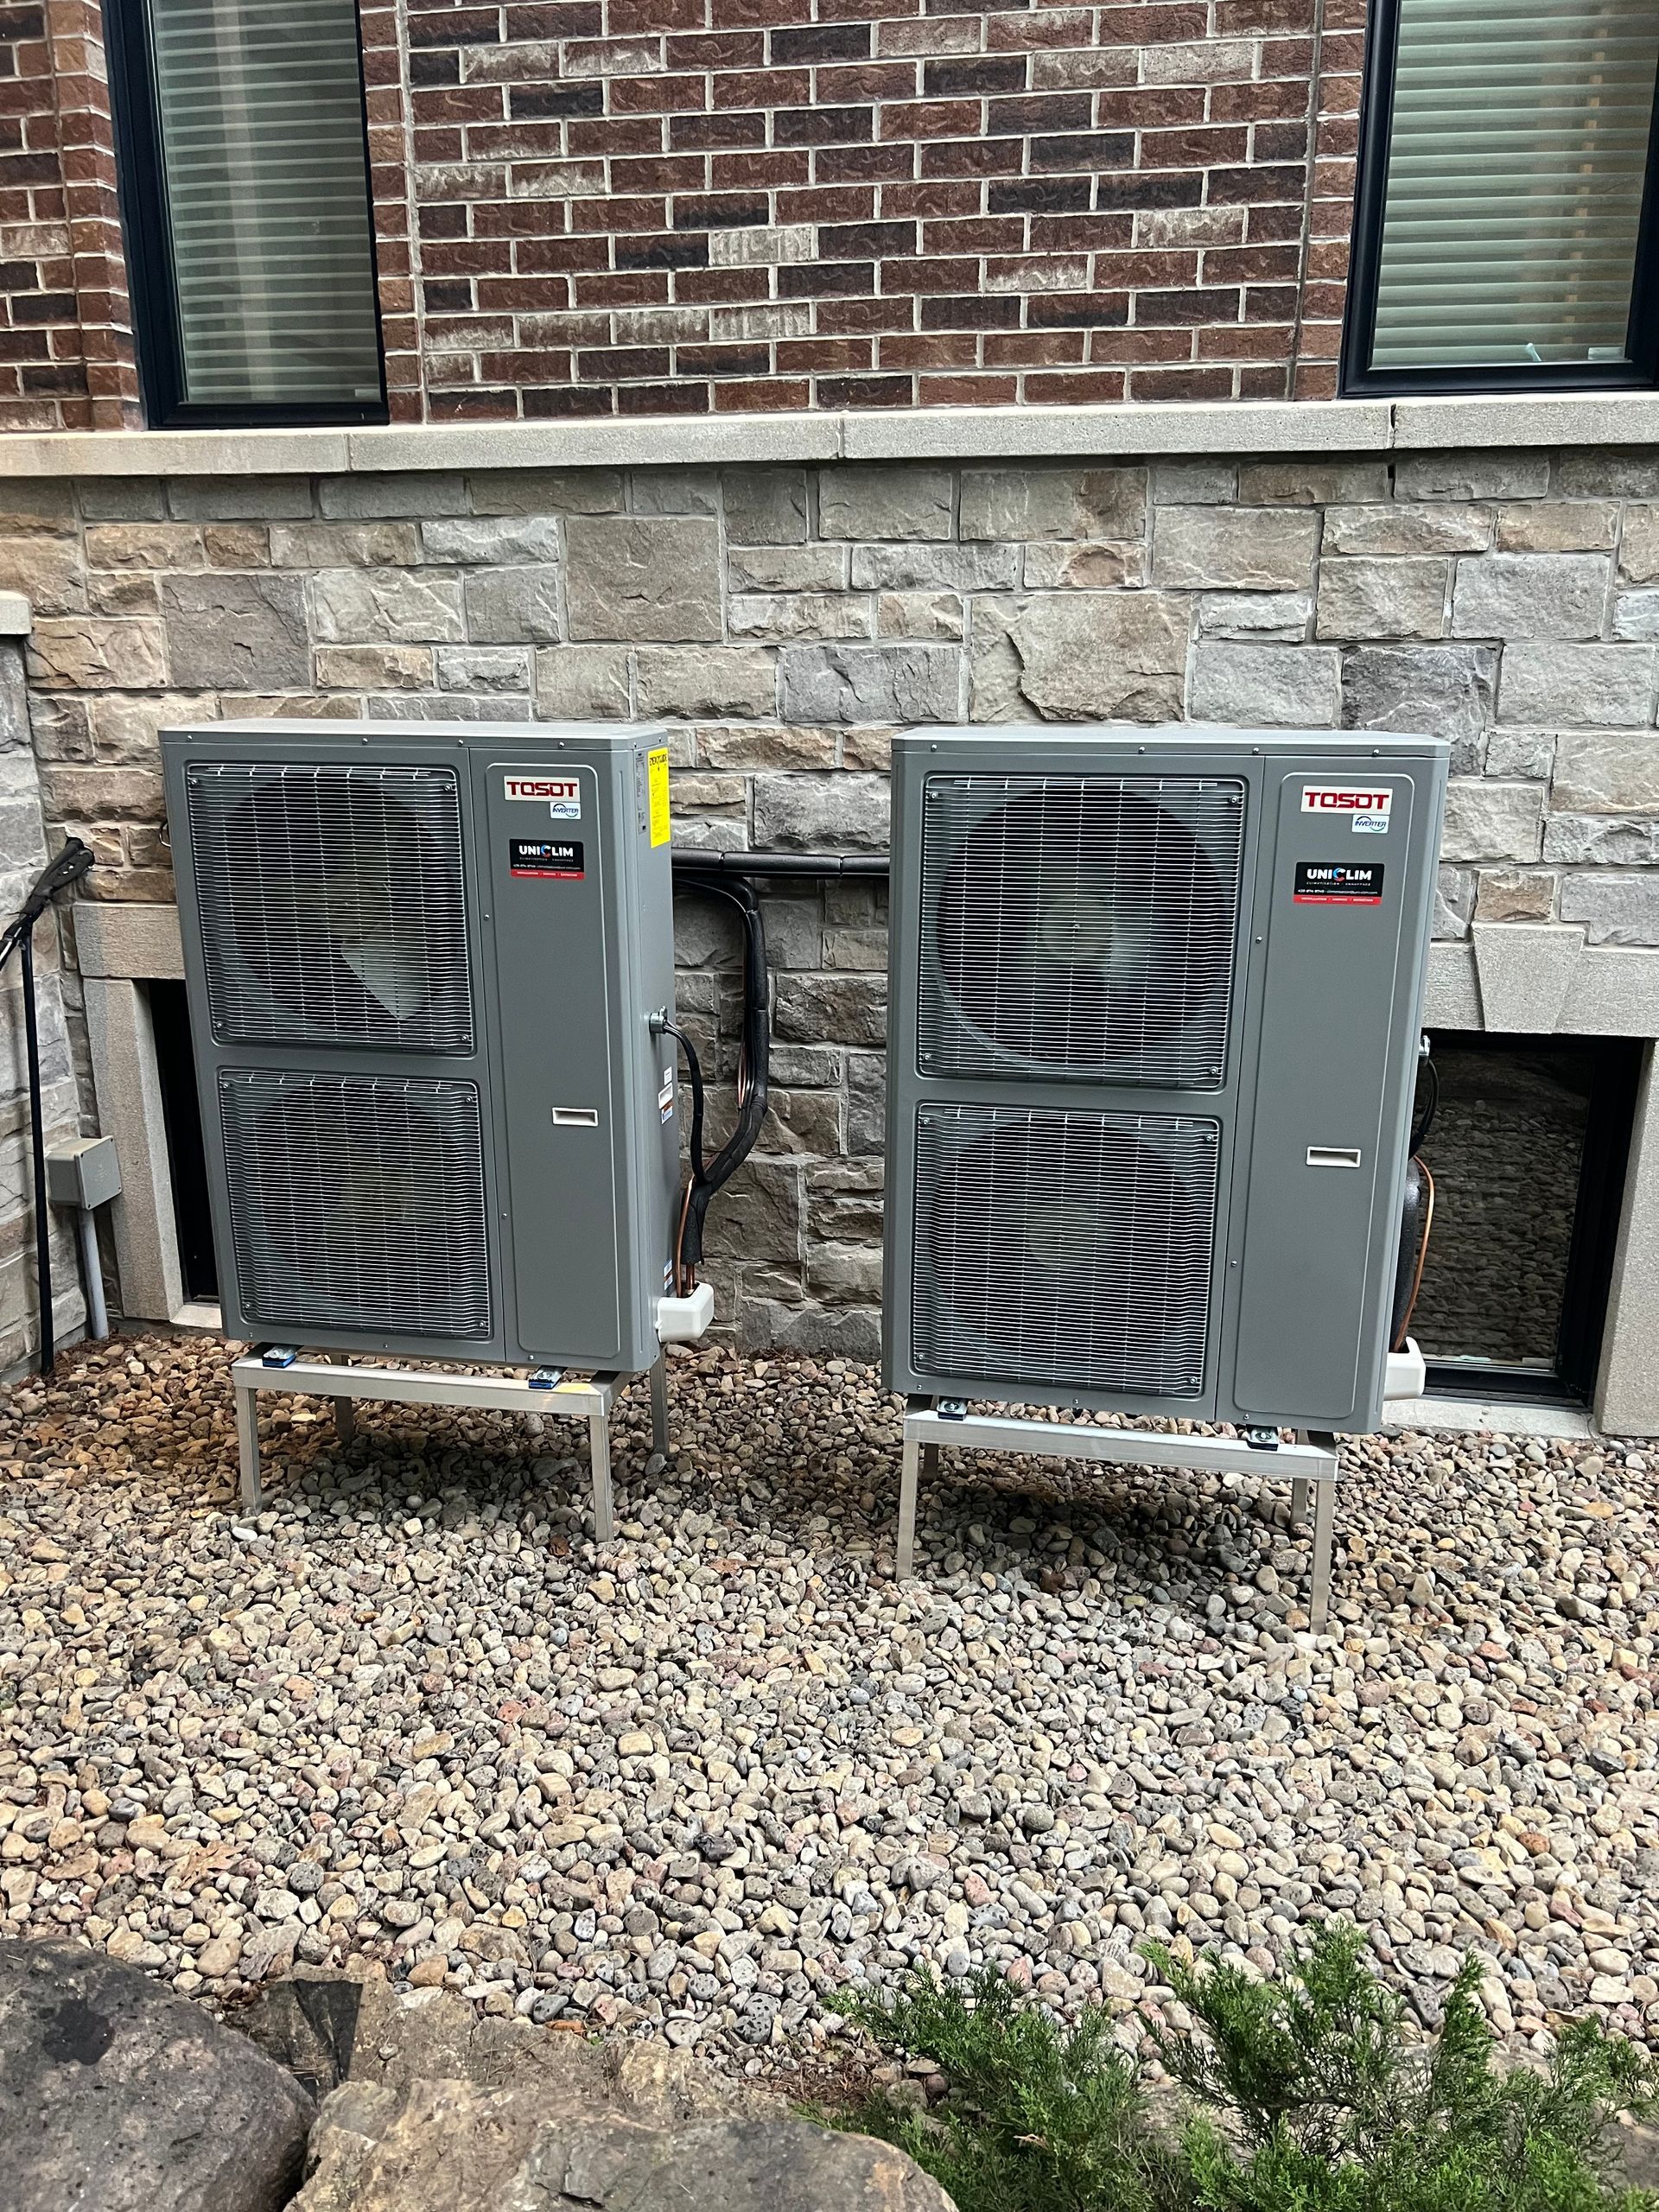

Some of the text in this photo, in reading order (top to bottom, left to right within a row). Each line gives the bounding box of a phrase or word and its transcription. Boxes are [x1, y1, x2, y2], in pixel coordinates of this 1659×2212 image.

[506, 781, 578, 797] TOSOT
[1305, 791, 1389, 809] TOSOT
[518, 845, 574, 857] UNICLIM
[1306, 868, 1372, 881] UNICLIM
